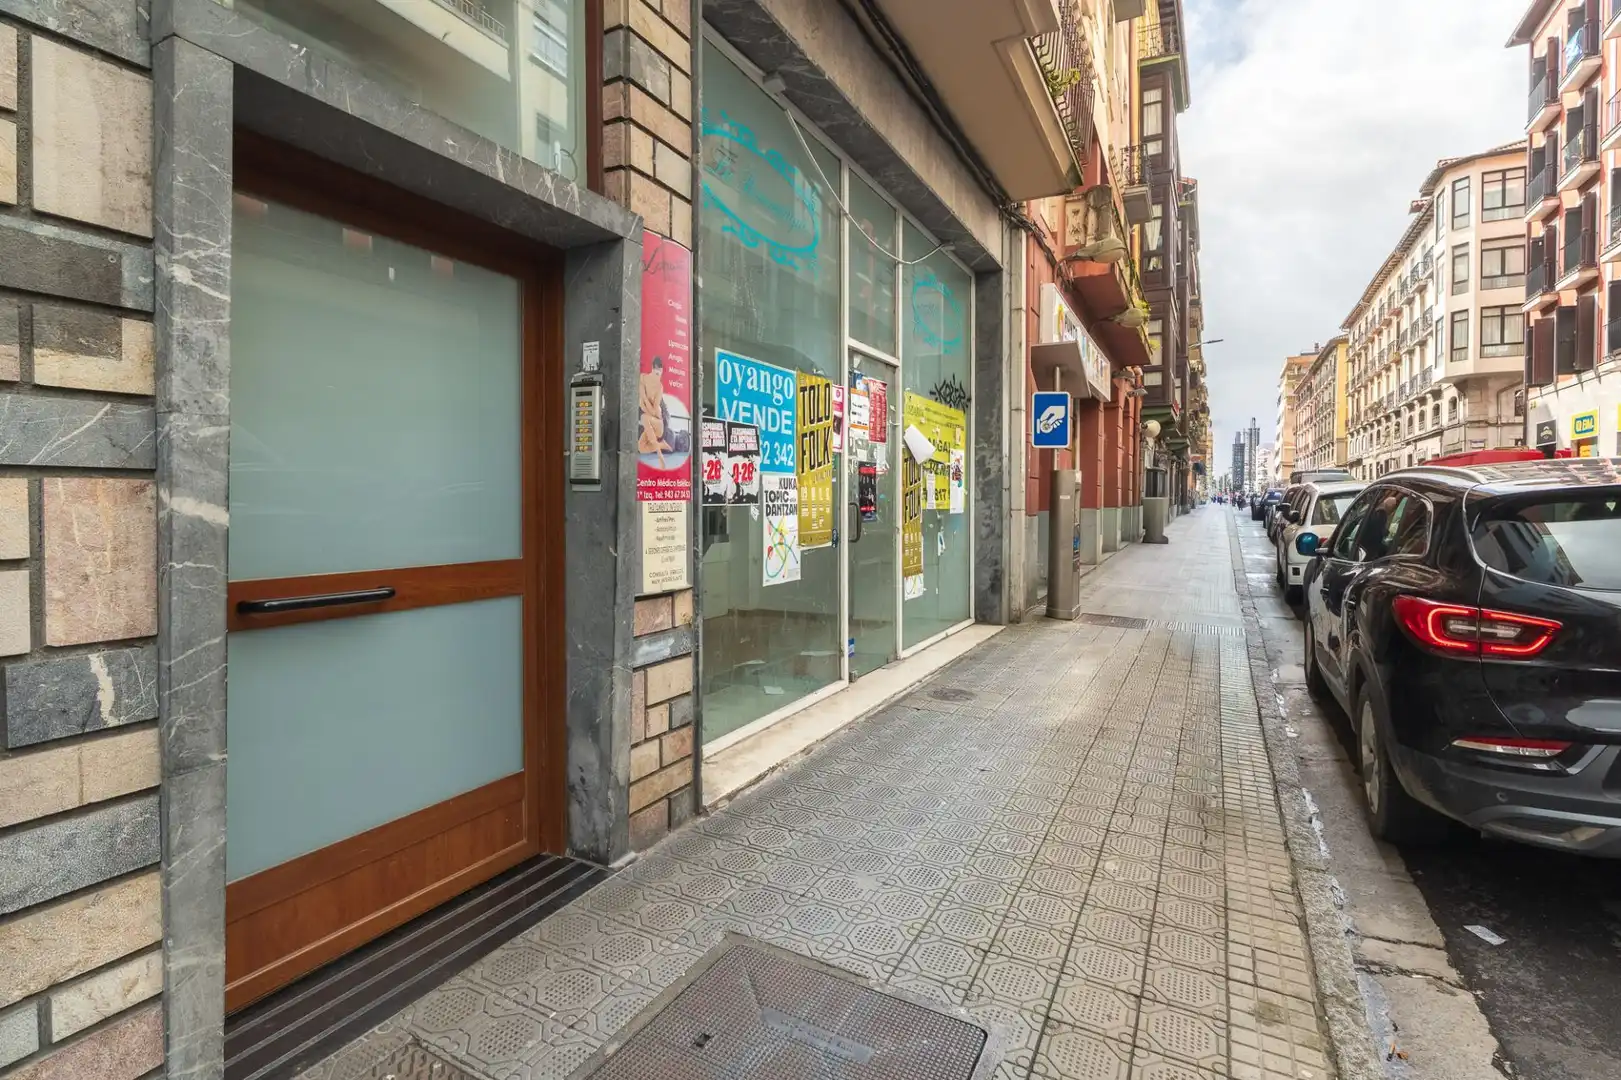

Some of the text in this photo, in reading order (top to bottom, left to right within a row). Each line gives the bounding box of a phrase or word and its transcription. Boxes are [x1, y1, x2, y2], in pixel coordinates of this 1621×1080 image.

[718, 359, 794, 405] oyango
[721, 397, 793, 435] VENDE
[800, 382, 831, 427] TOLO
[773, 443, 794, 467] 342
[801, 427, 831, 474] FOLK
[664, 490, 674, 499] 943
[779, 478, 797, 490] KUKA
[764, 491, 789, 503] TOPIC
[766, 503, 797, 517] DANTZAN
